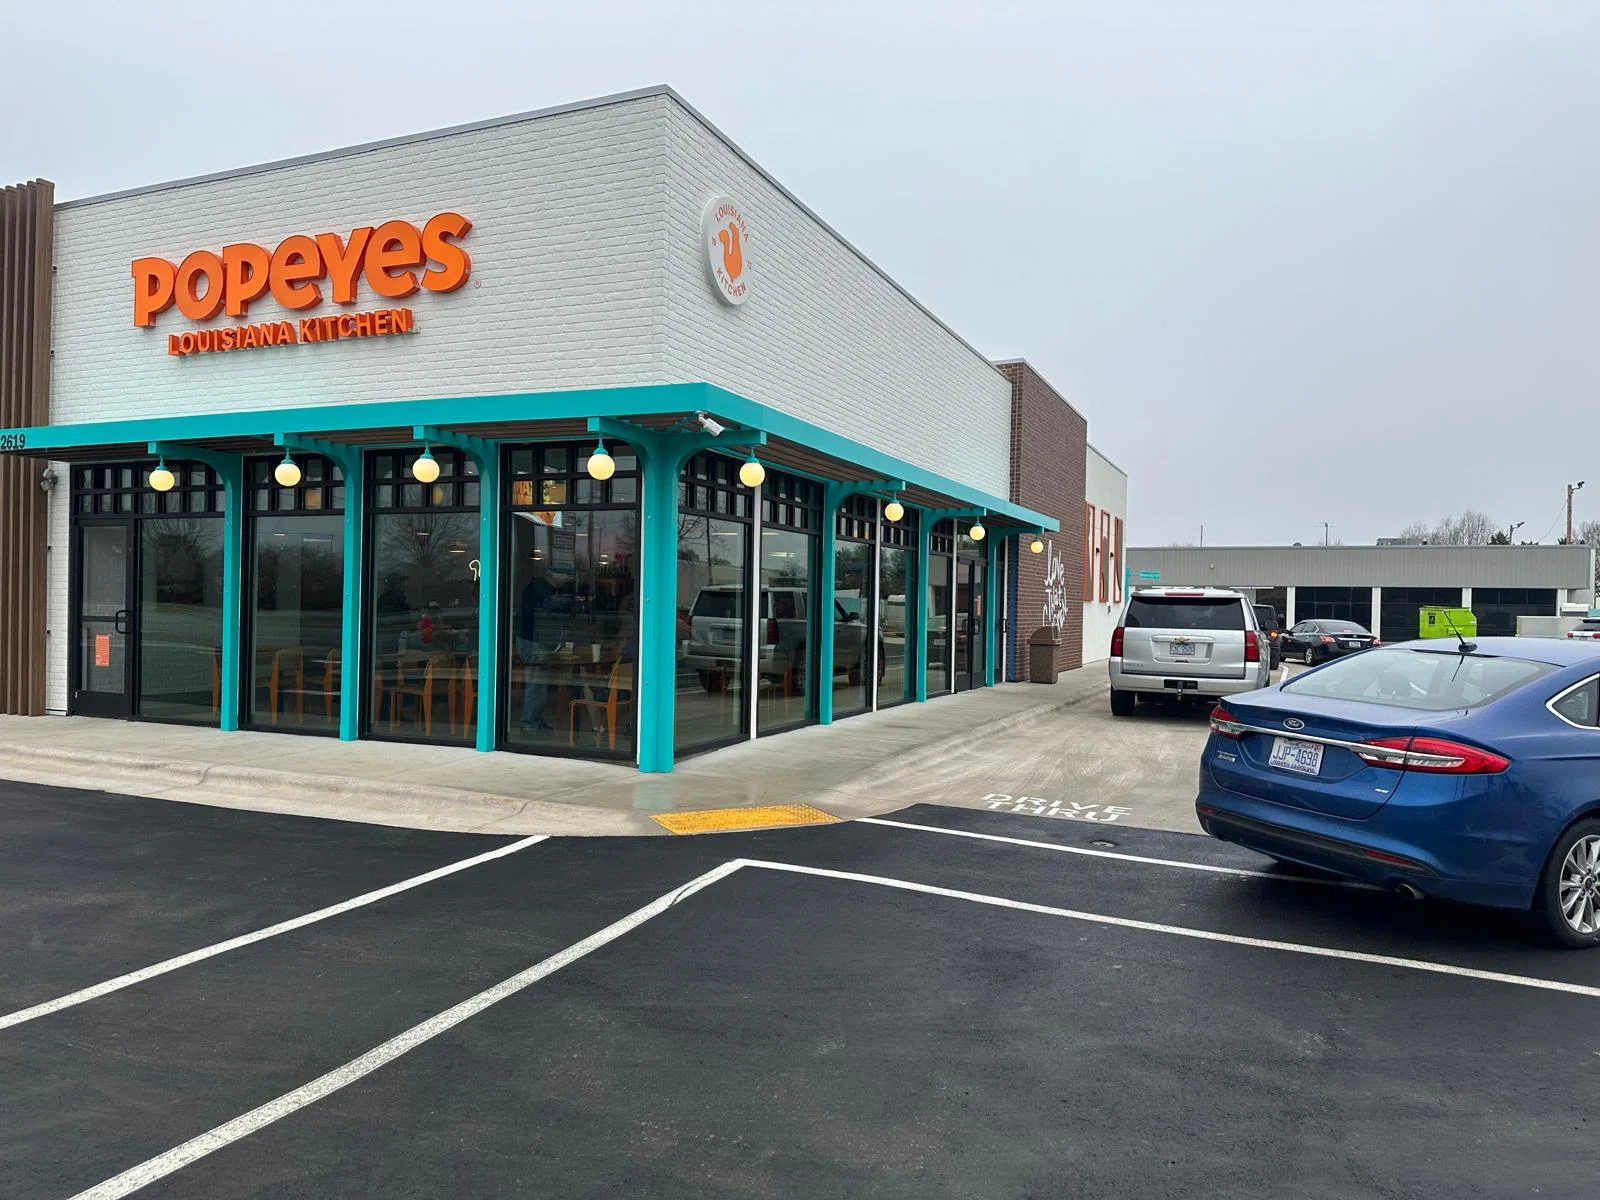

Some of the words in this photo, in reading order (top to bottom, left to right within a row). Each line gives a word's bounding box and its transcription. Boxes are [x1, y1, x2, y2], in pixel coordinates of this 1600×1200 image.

[715, 204, 749, 242] LOUISIANA
[716, 267, 747, 297] KITCHEN
[168, 320, 298, 356] LOUISIANA
[299, 308, 415, 343] KITCHEN
[1, 434, 26, 449] 2619
[981, 793, 1134, 816] DRIVE
[986, 800, 1121, 822] THRU
